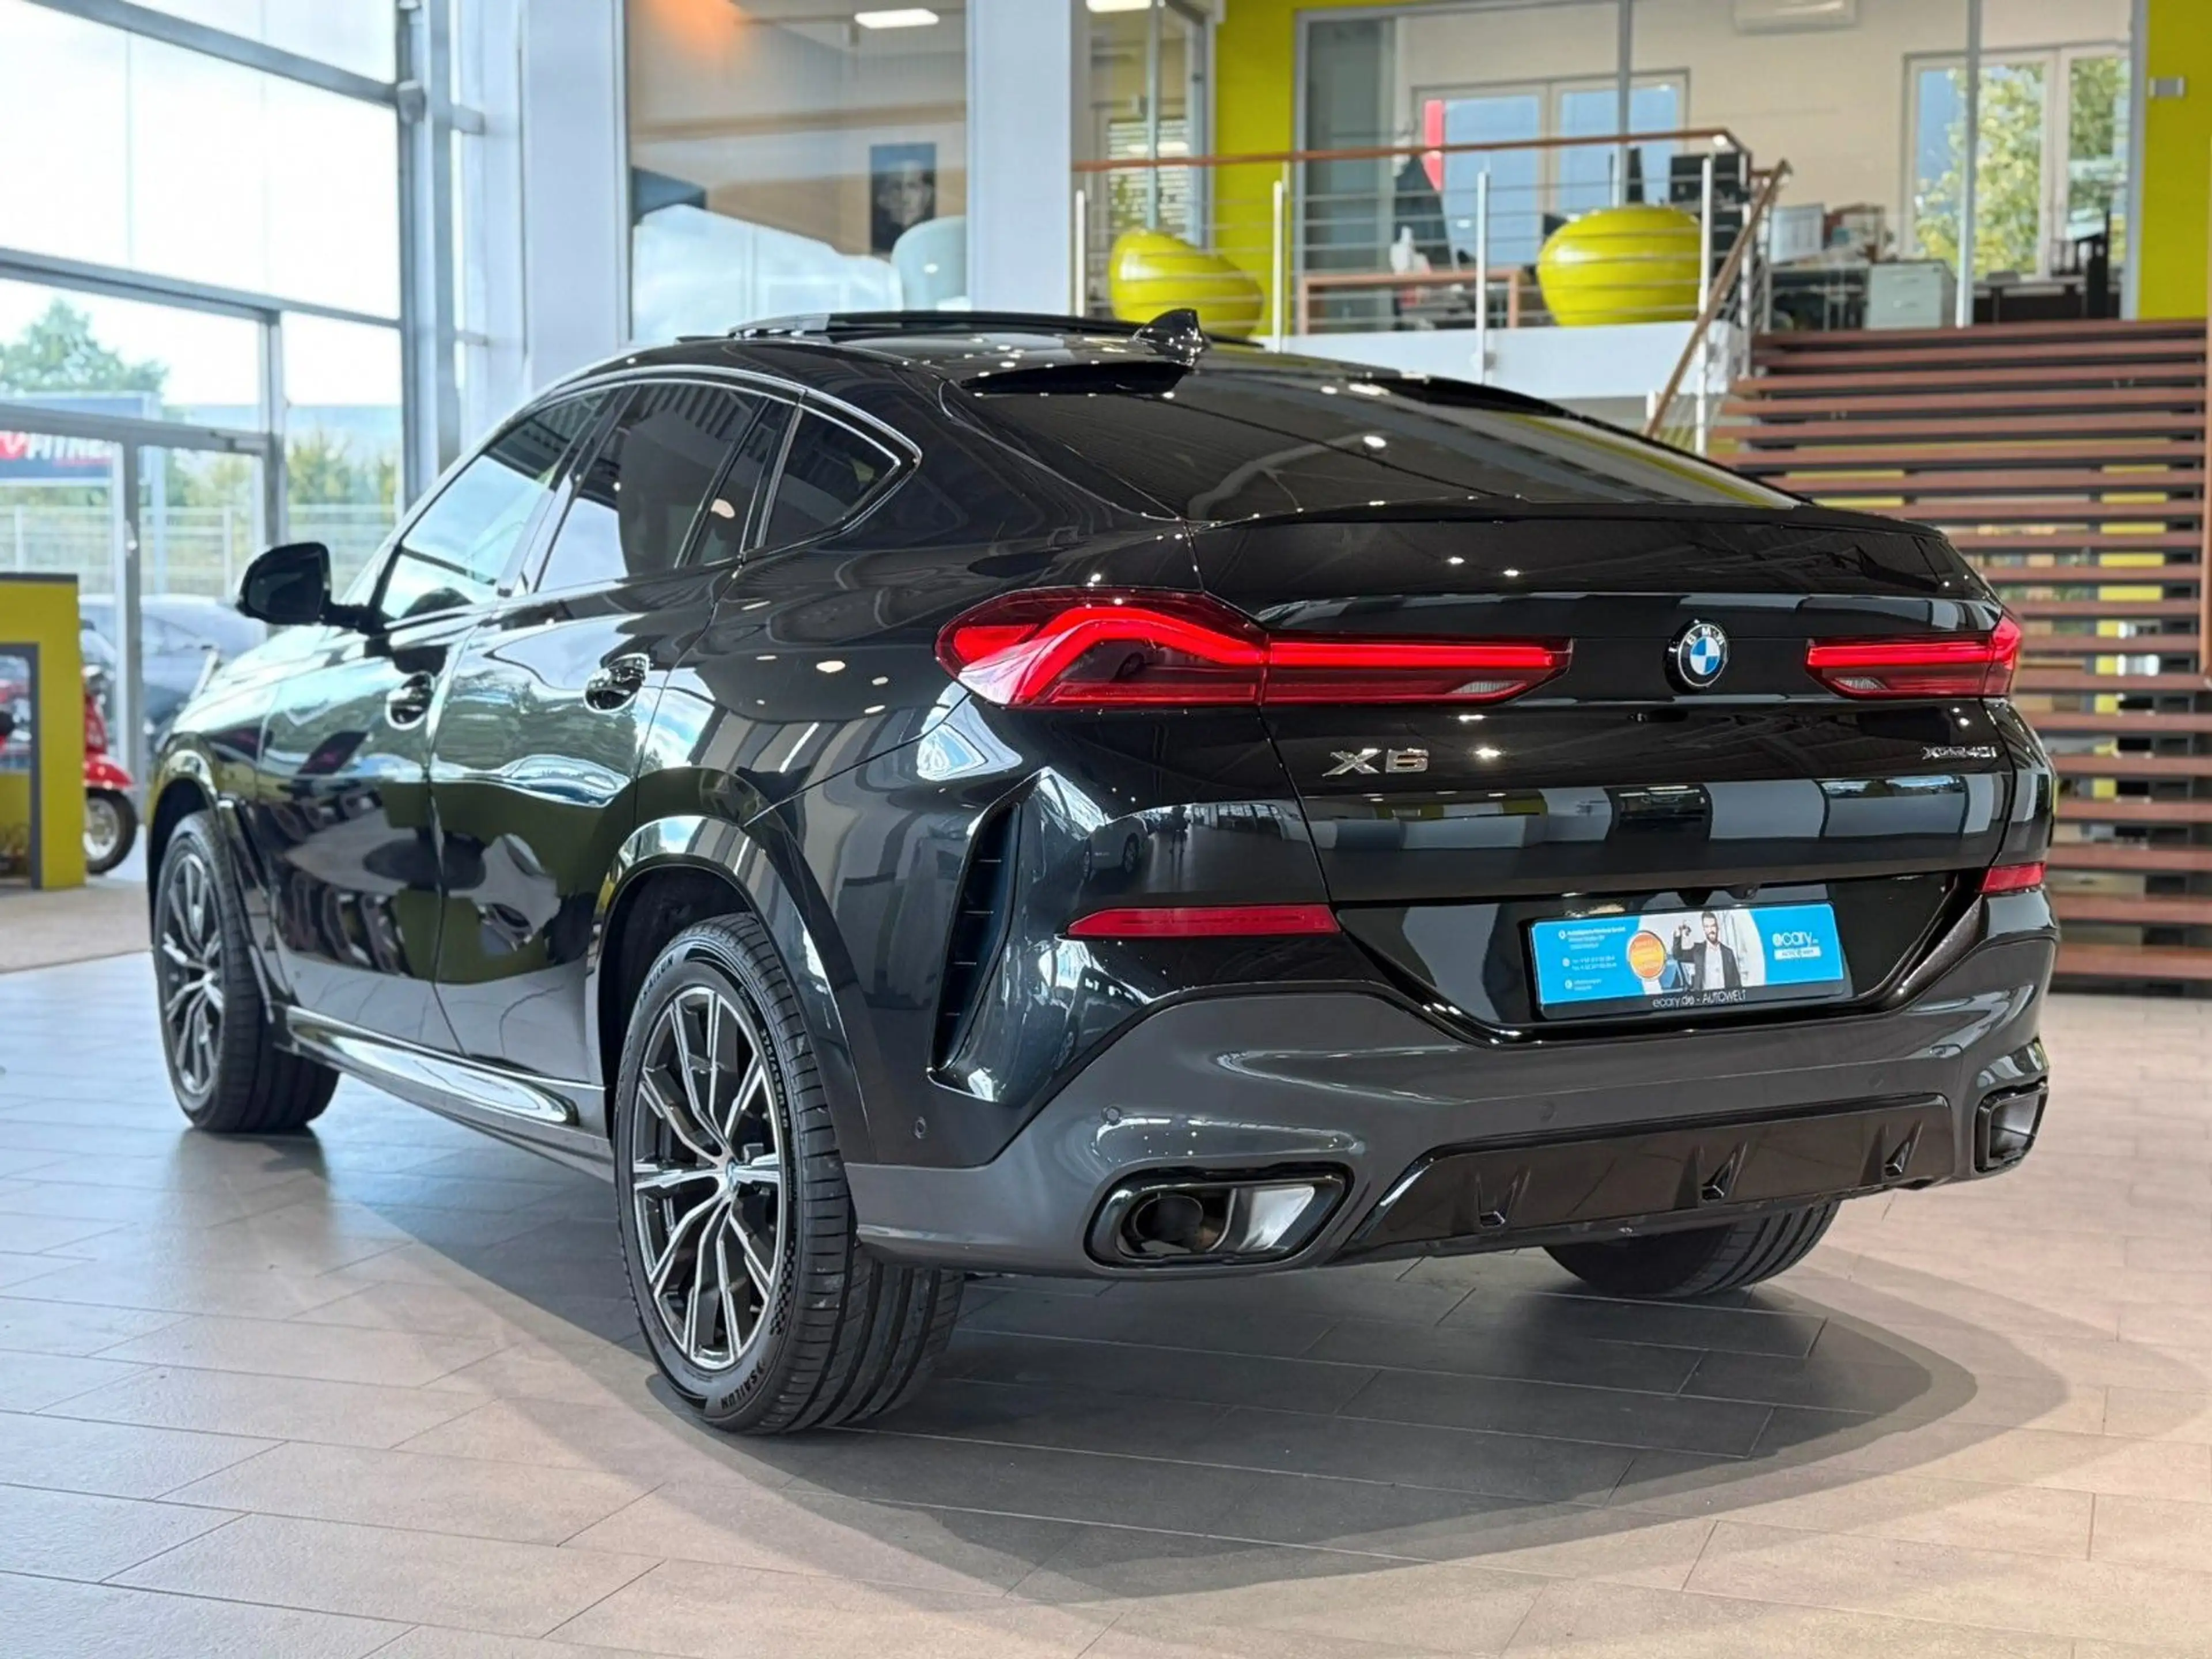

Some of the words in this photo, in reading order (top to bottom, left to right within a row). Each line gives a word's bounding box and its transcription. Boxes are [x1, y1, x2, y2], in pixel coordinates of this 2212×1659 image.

[1686, 626, 1725, 646] BMW
[1322, 748, 1429, 777] X6
[720, 1369, 758, 1410] SAILUN
